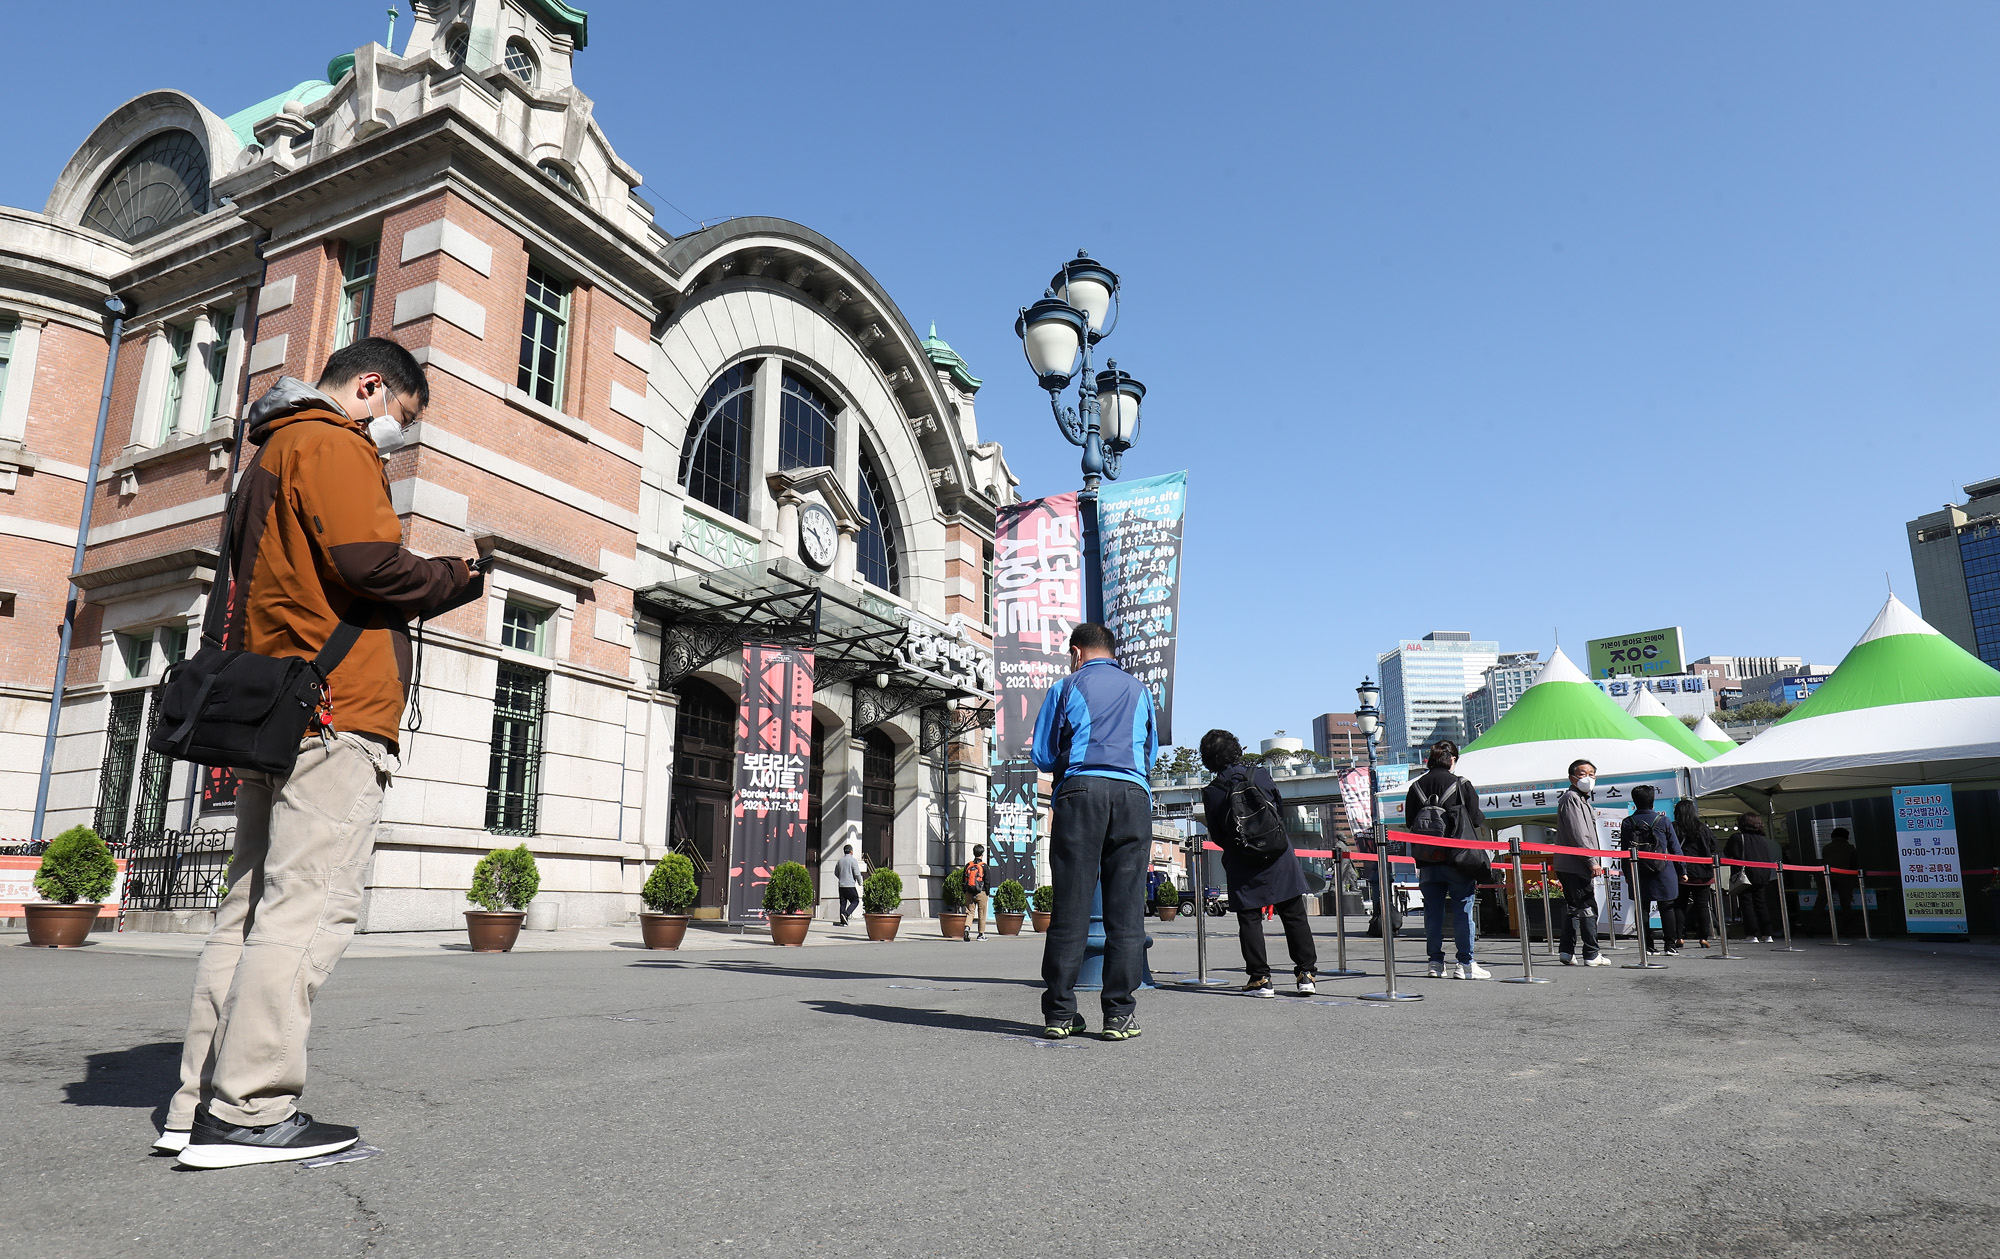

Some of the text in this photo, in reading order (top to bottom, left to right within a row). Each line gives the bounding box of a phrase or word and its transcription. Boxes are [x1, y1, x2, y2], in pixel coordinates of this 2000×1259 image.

[1101, 491, 1180, 514] Border-less.site
[1101, 518, 1177, 542] Border-less.site
[1406, 643, 1423, 651] AIA
[1600, 633, 1665, 650] 기본이 좋아요 진에어
[907, 620, 993, 688] 문화역서울28
[743, 753, 804, 773] 보더리스
[749, 769, 796, 789] 사이트
[741, 788, 803, 801] Border-less.site
[1904, 795, 1942, 806] 코로나19
[994, 801, 1034, 815] 보더리스
[1899, 806, 1950, 818] 중구선별검사소
[999, 812, 1029, 827] 사이트
[1603, 820, 1621, 828] 코로나
[1907, 818, 1944, 829] 운영시간
[1902, 847, 1955, 857] 09:00~17:00
[1904, 873, 1959, 883] 09:00~13:00
